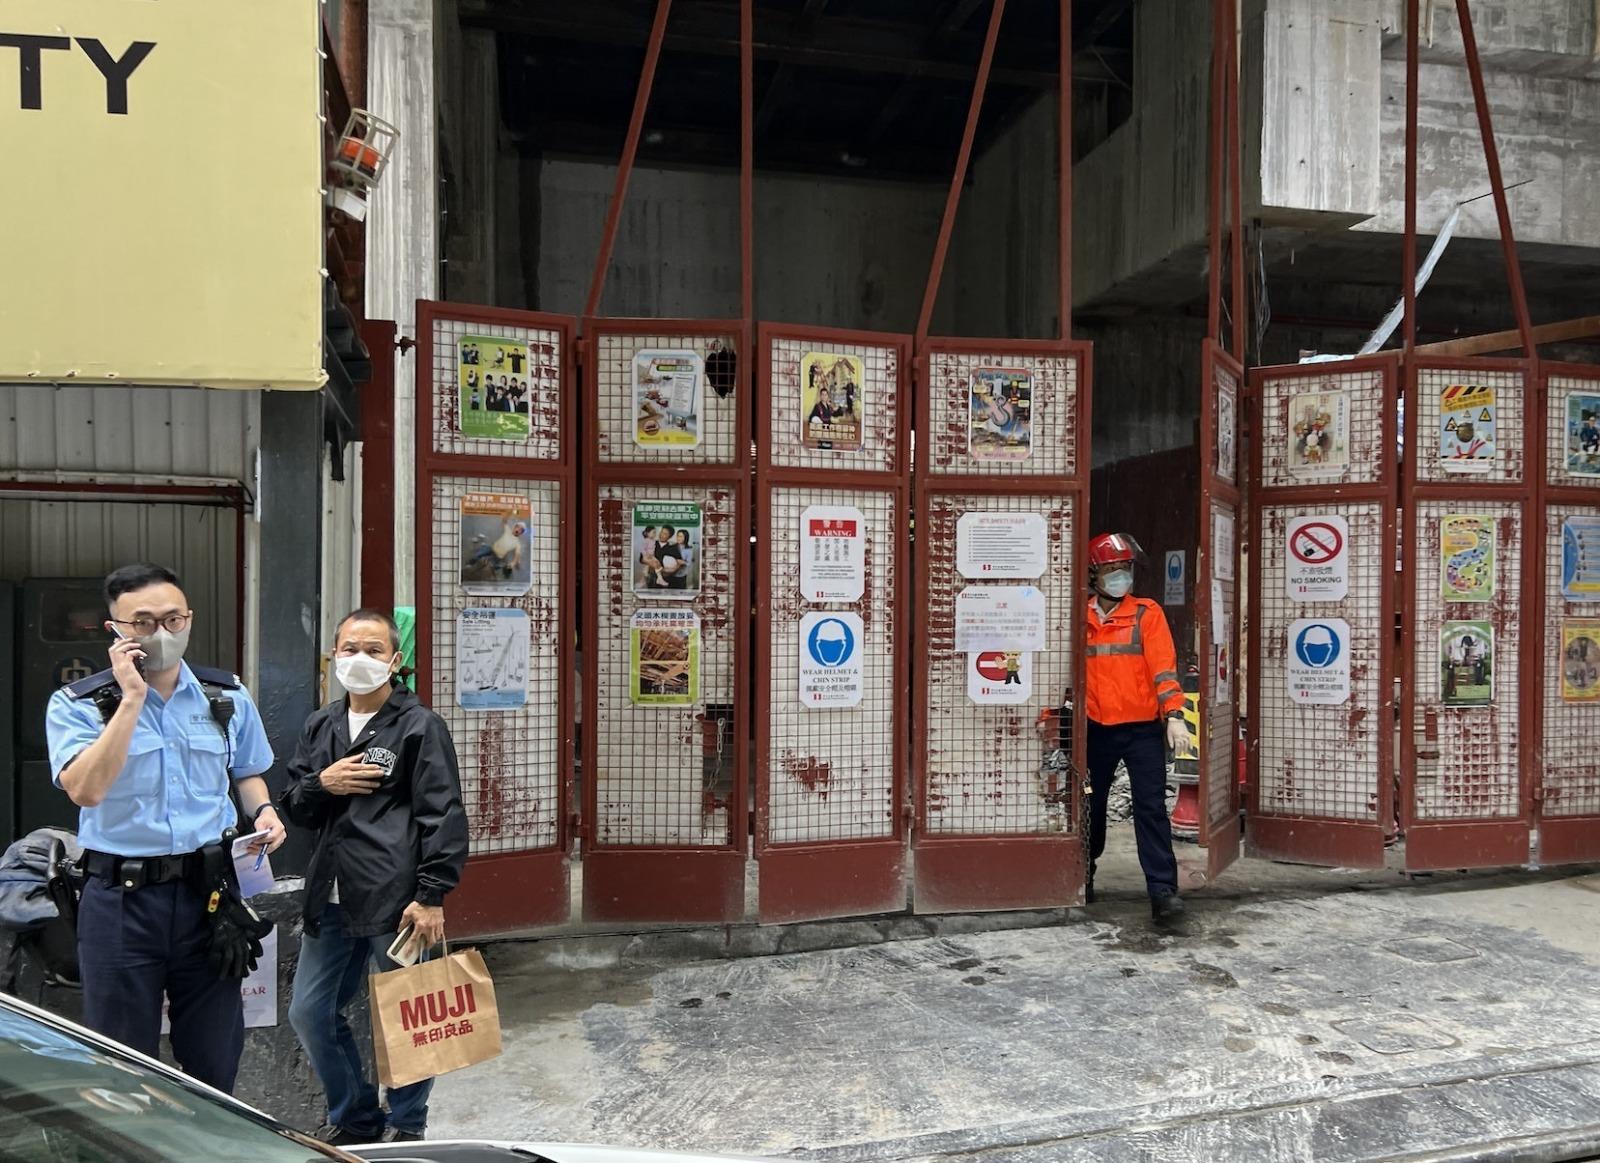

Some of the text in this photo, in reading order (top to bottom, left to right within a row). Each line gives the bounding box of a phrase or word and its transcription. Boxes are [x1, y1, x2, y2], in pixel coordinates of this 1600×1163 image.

[0, 33, 157, 115] TY
[814, 529, 852, 537] WARNING
[1304, 576, 1342, 584] SMOKING
[241, 986, 266, 996] EAR
[399, 983, 477, 1031] MUJI
[412, 1019, 474, 1048] 無印良品
